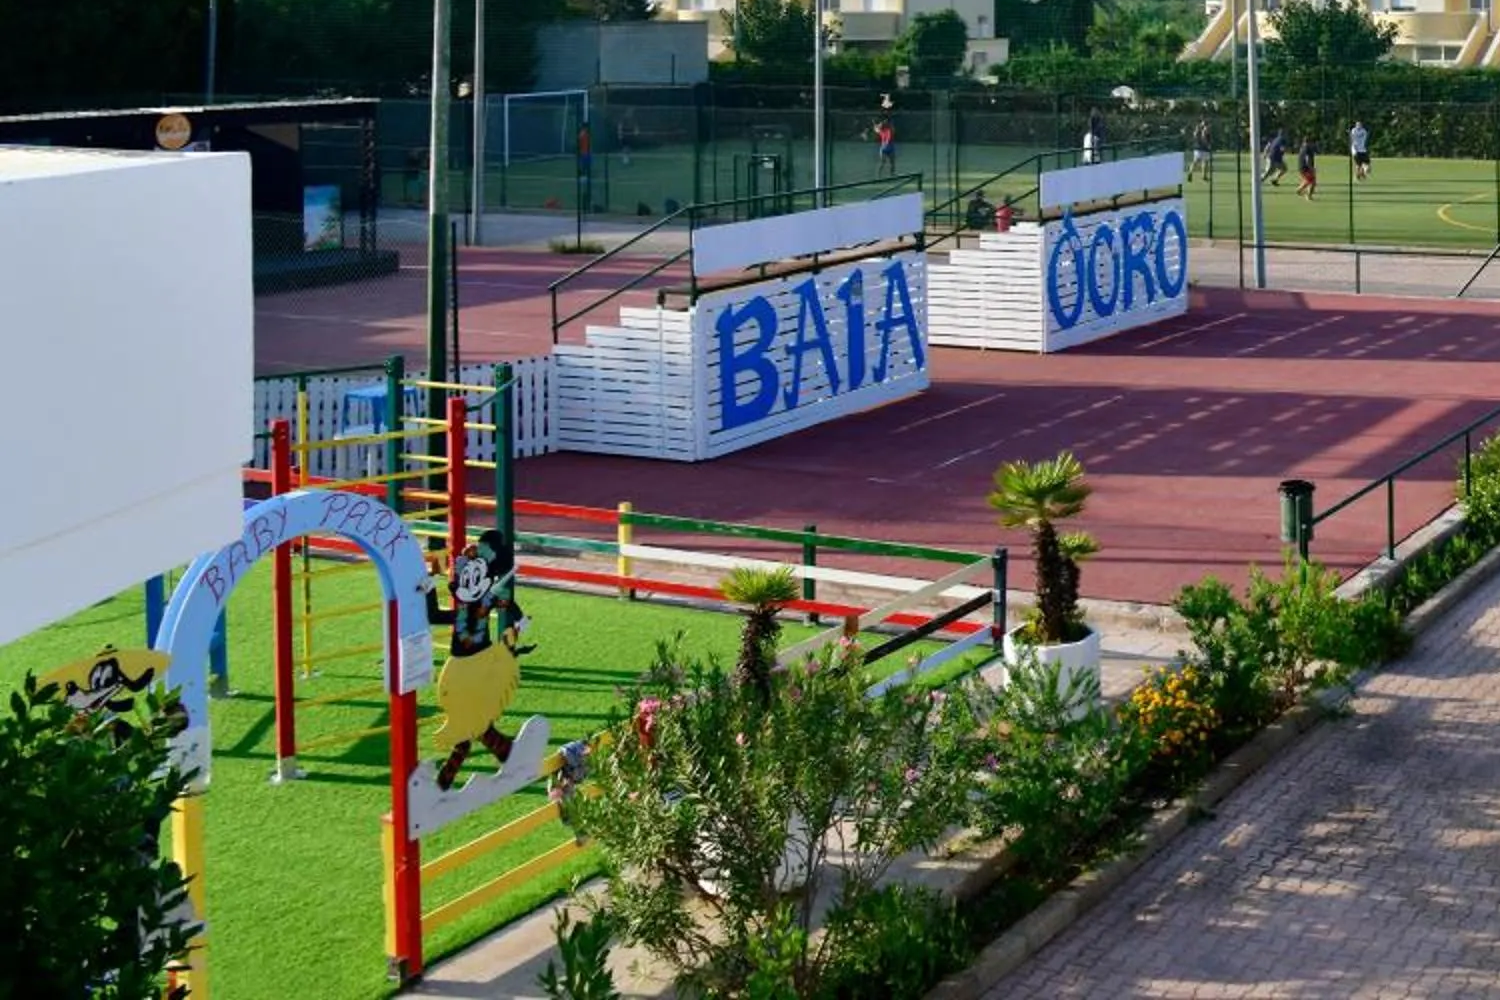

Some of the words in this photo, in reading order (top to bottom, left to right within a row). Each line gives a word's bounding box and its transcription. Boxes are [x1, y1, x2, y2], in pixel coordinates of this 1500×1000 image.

[715, 260, 925, 430] BAIA
[200, 507, 288, 605] BABY
[319, 493, 408, 561] PARK
